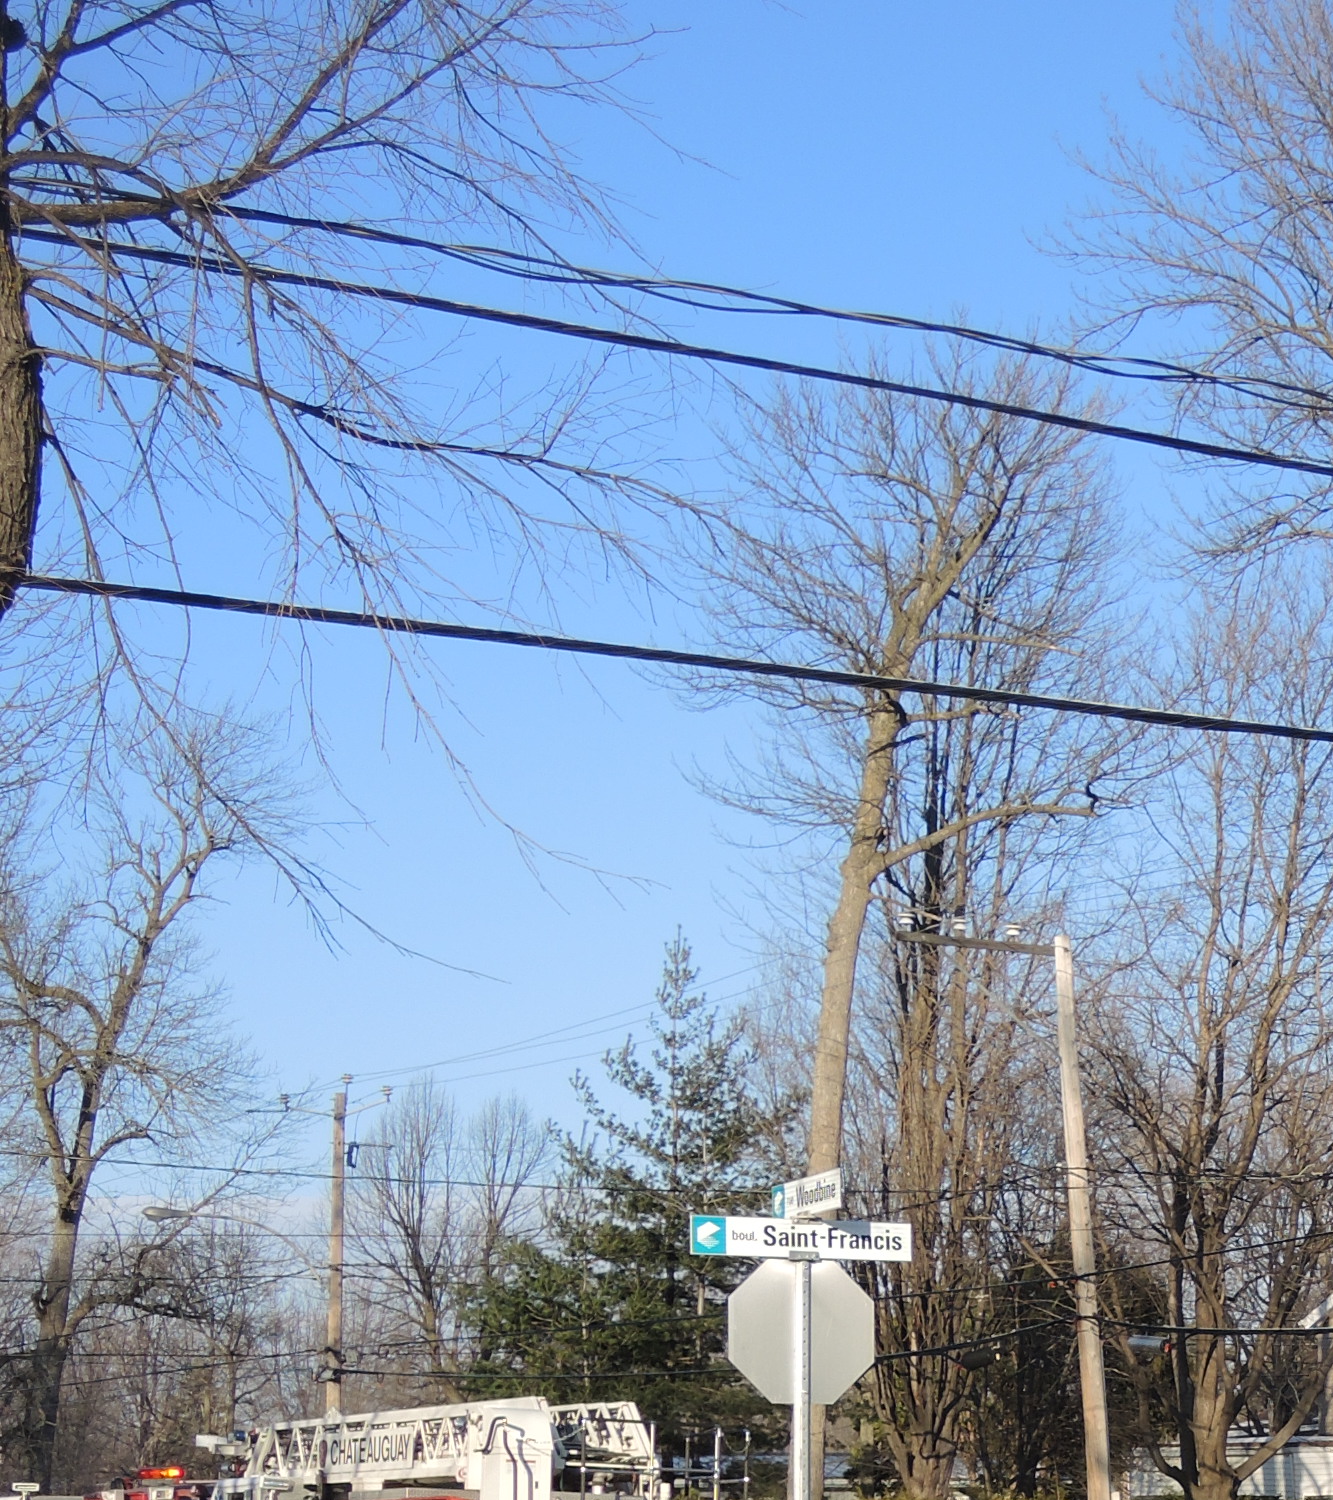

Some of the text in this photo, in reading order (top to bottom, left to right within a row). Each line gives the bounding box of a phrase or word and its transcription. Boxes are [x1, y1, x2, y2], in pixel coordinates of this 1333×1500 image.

[795, 1178, 836, 1209] Woodbine
[732, 1225, 903, 1251] boul. Saint-Francis
